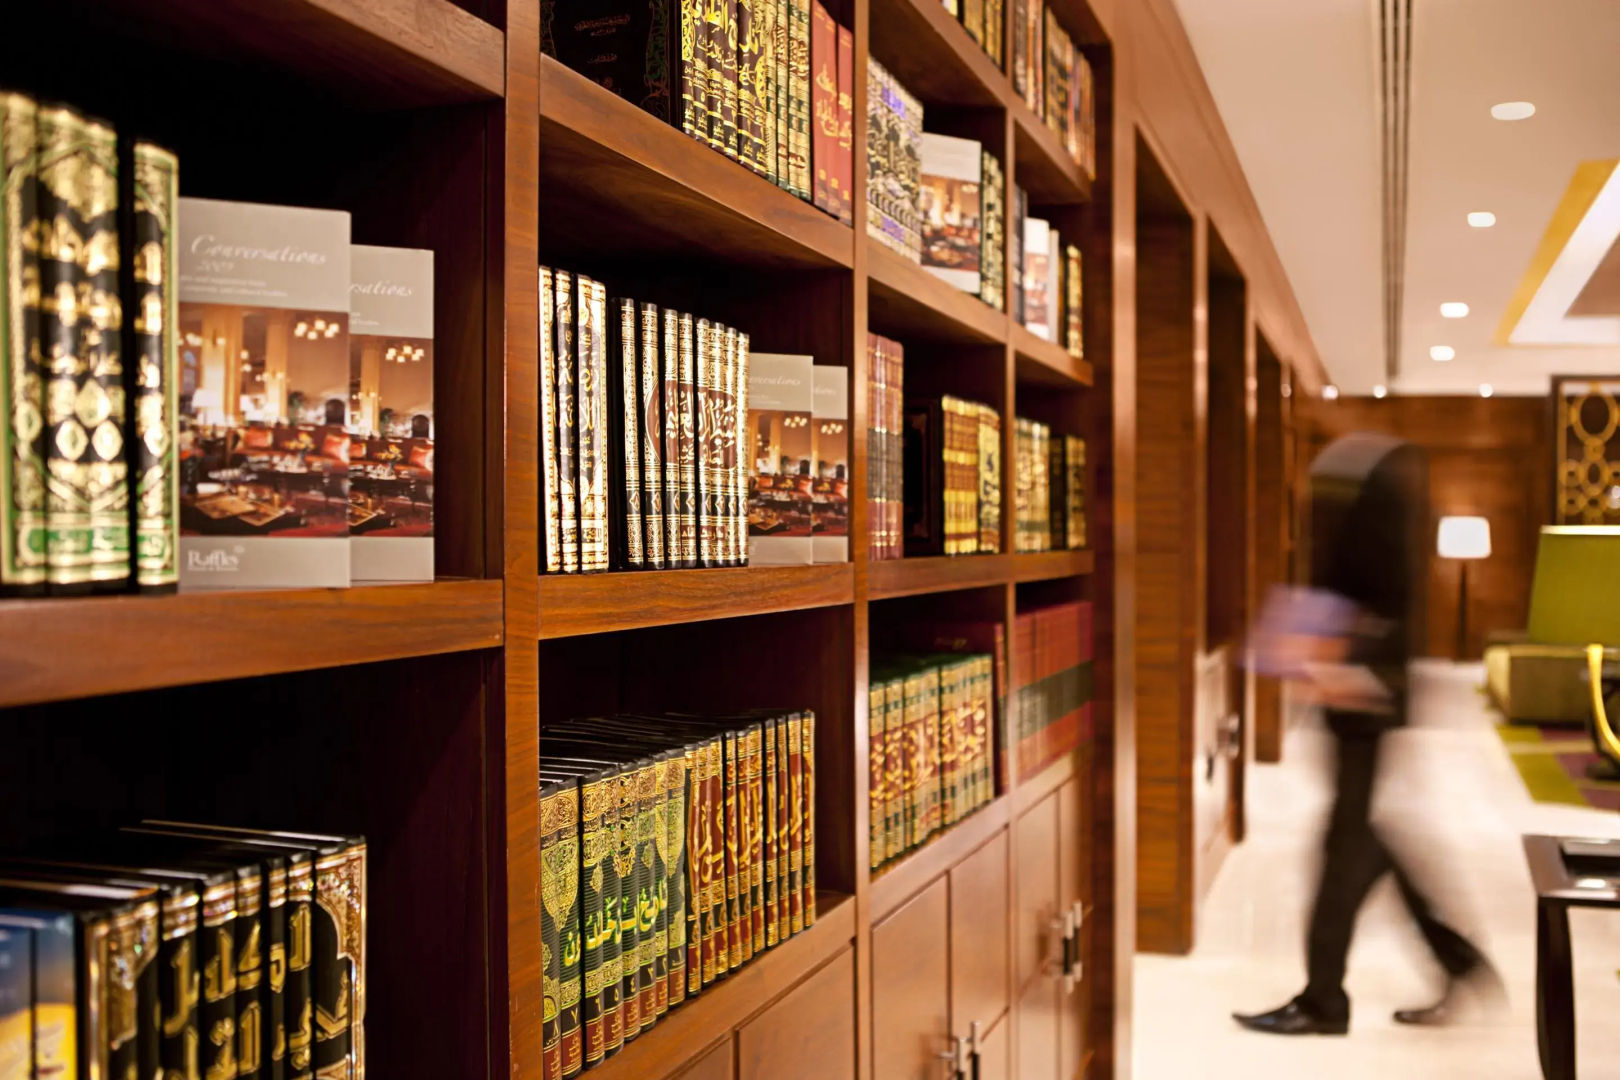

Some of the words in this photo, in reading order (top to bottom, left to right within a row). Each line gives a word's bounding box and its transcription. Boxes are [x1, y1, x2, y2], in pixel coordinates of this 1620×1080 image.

[191, 234, 326, 265] Conversations
[349, 280, 413, 297] rsations
[187, 551, 240, 567] Raffles
